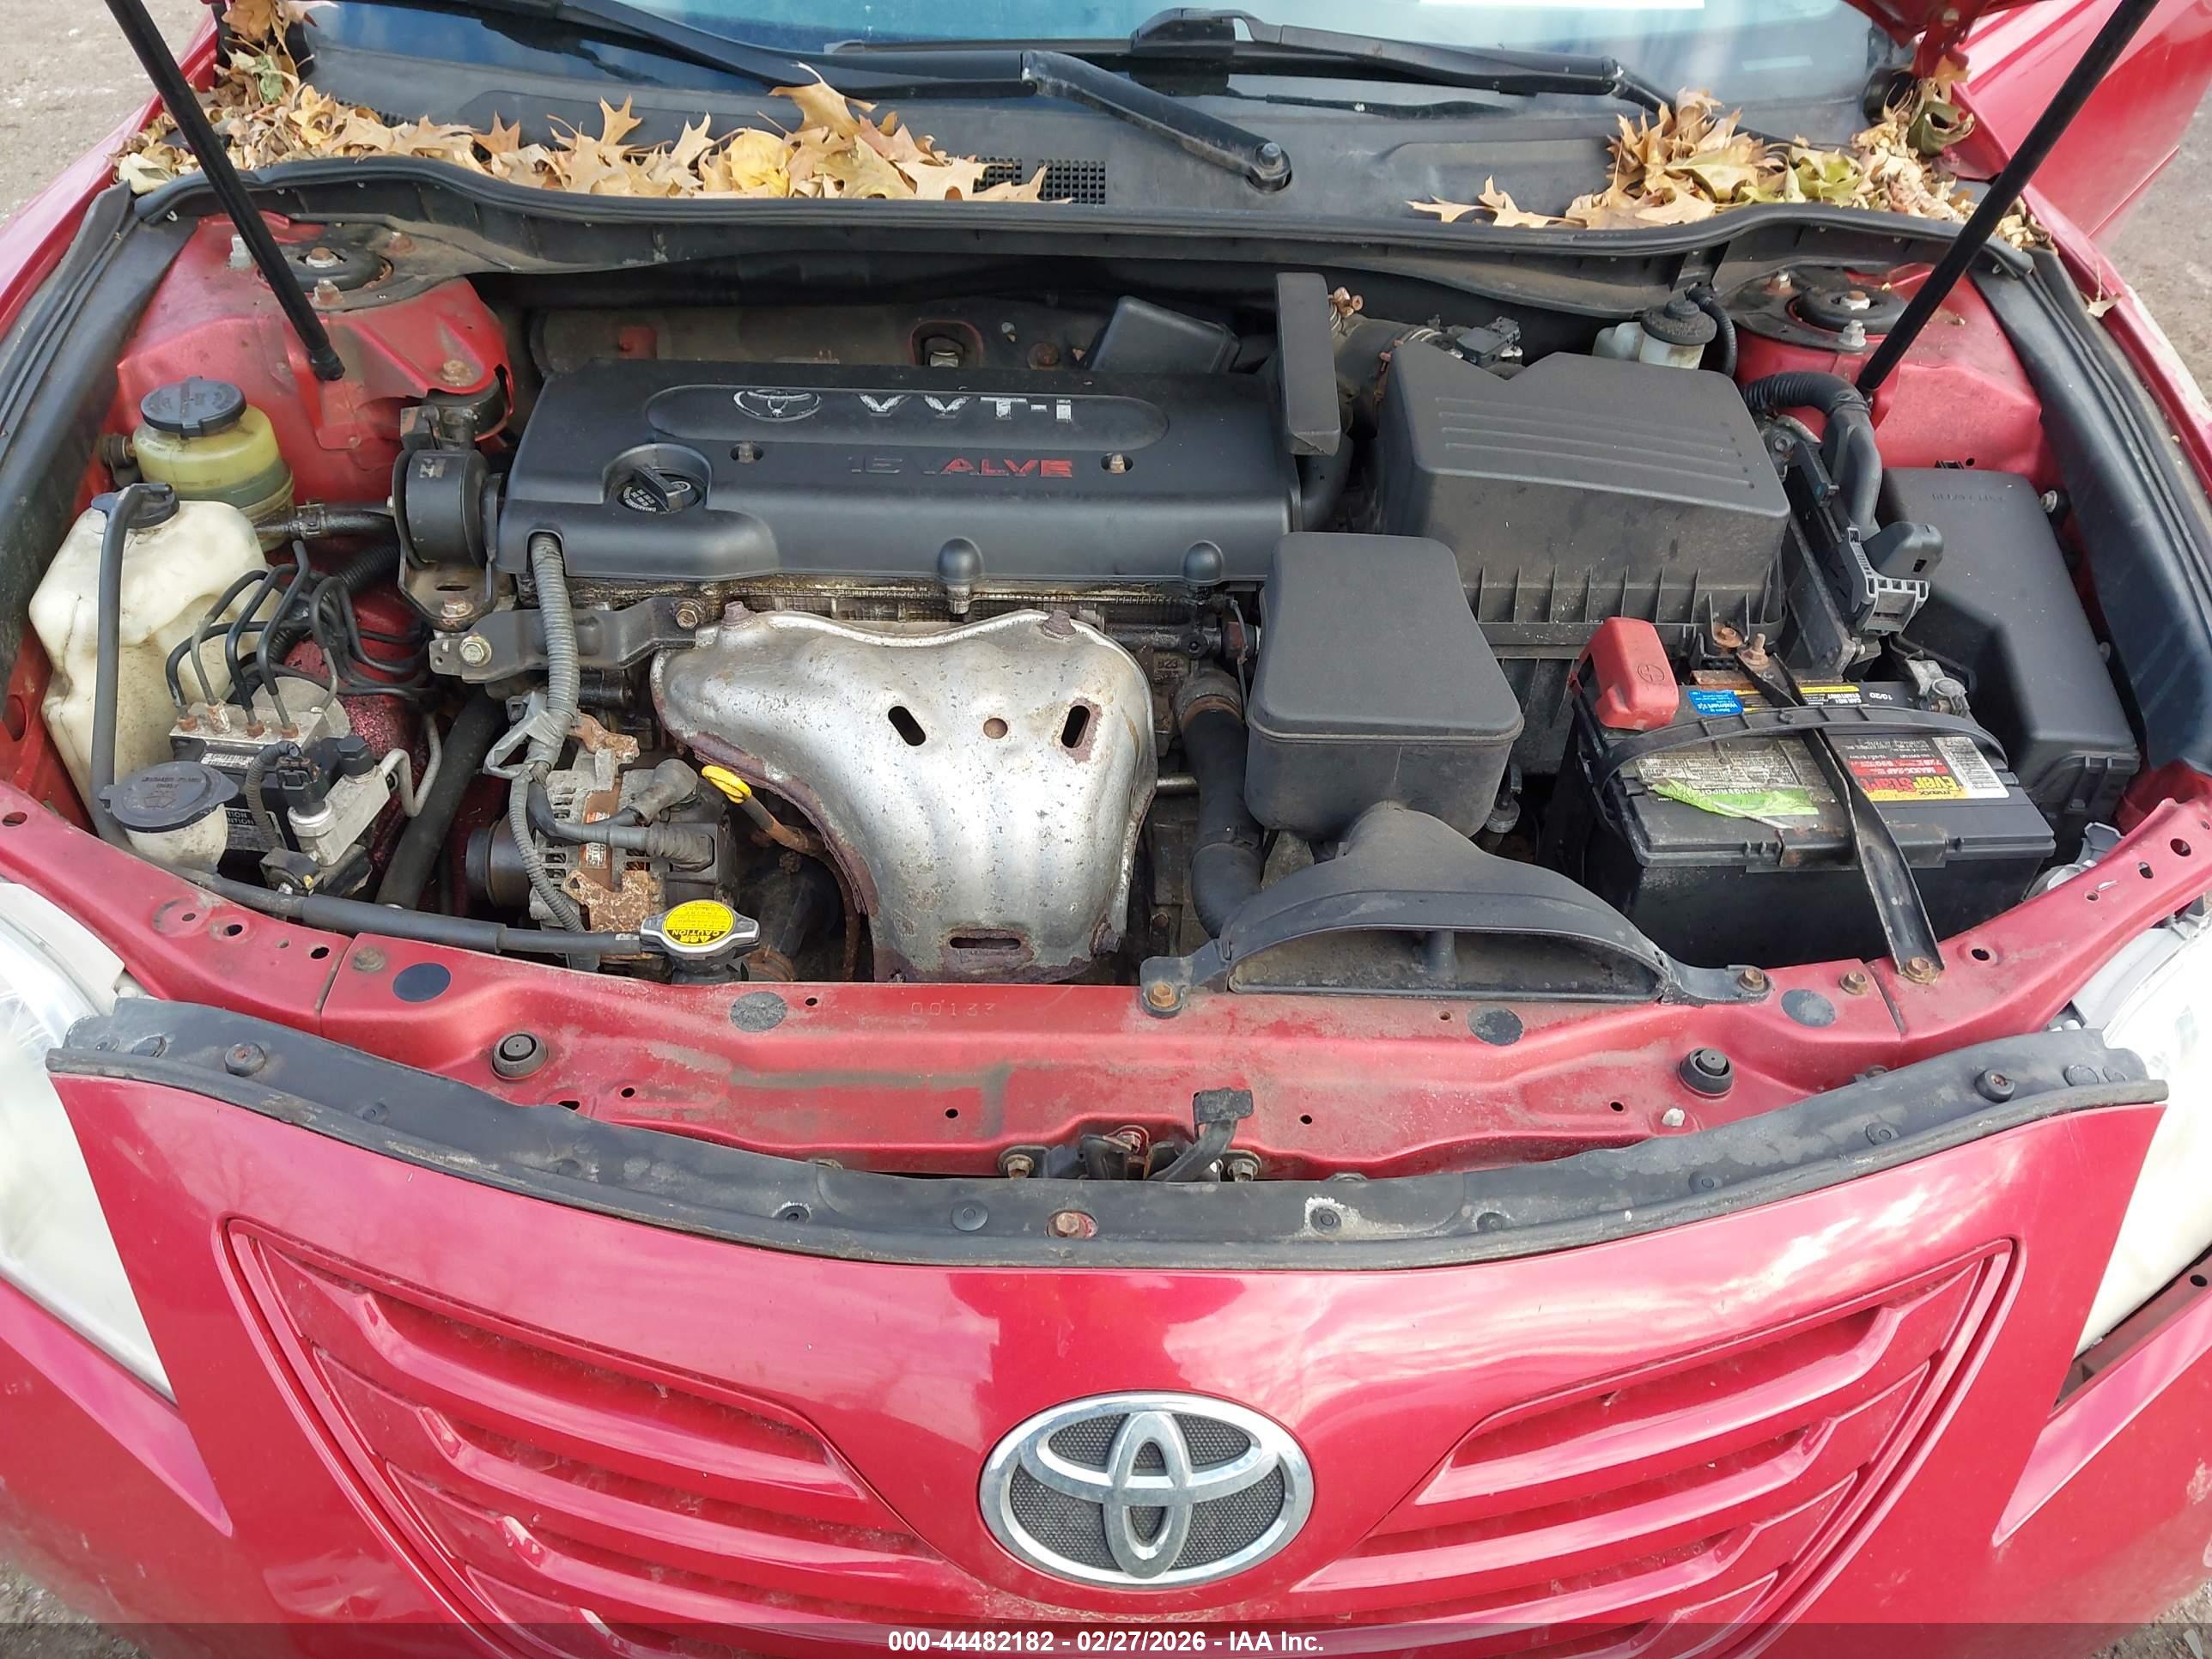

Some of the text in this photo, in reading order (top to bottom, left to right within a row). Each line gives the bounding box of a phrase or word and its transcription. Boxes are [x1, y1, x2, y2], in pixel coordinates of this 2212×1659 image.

[922, 458, 1073, 477] ALVE
[1869, 691, 1893, 702] 10/20
[1859, 775, 1960, 793] EverStart
[227, 817, 255, 825] NTION
